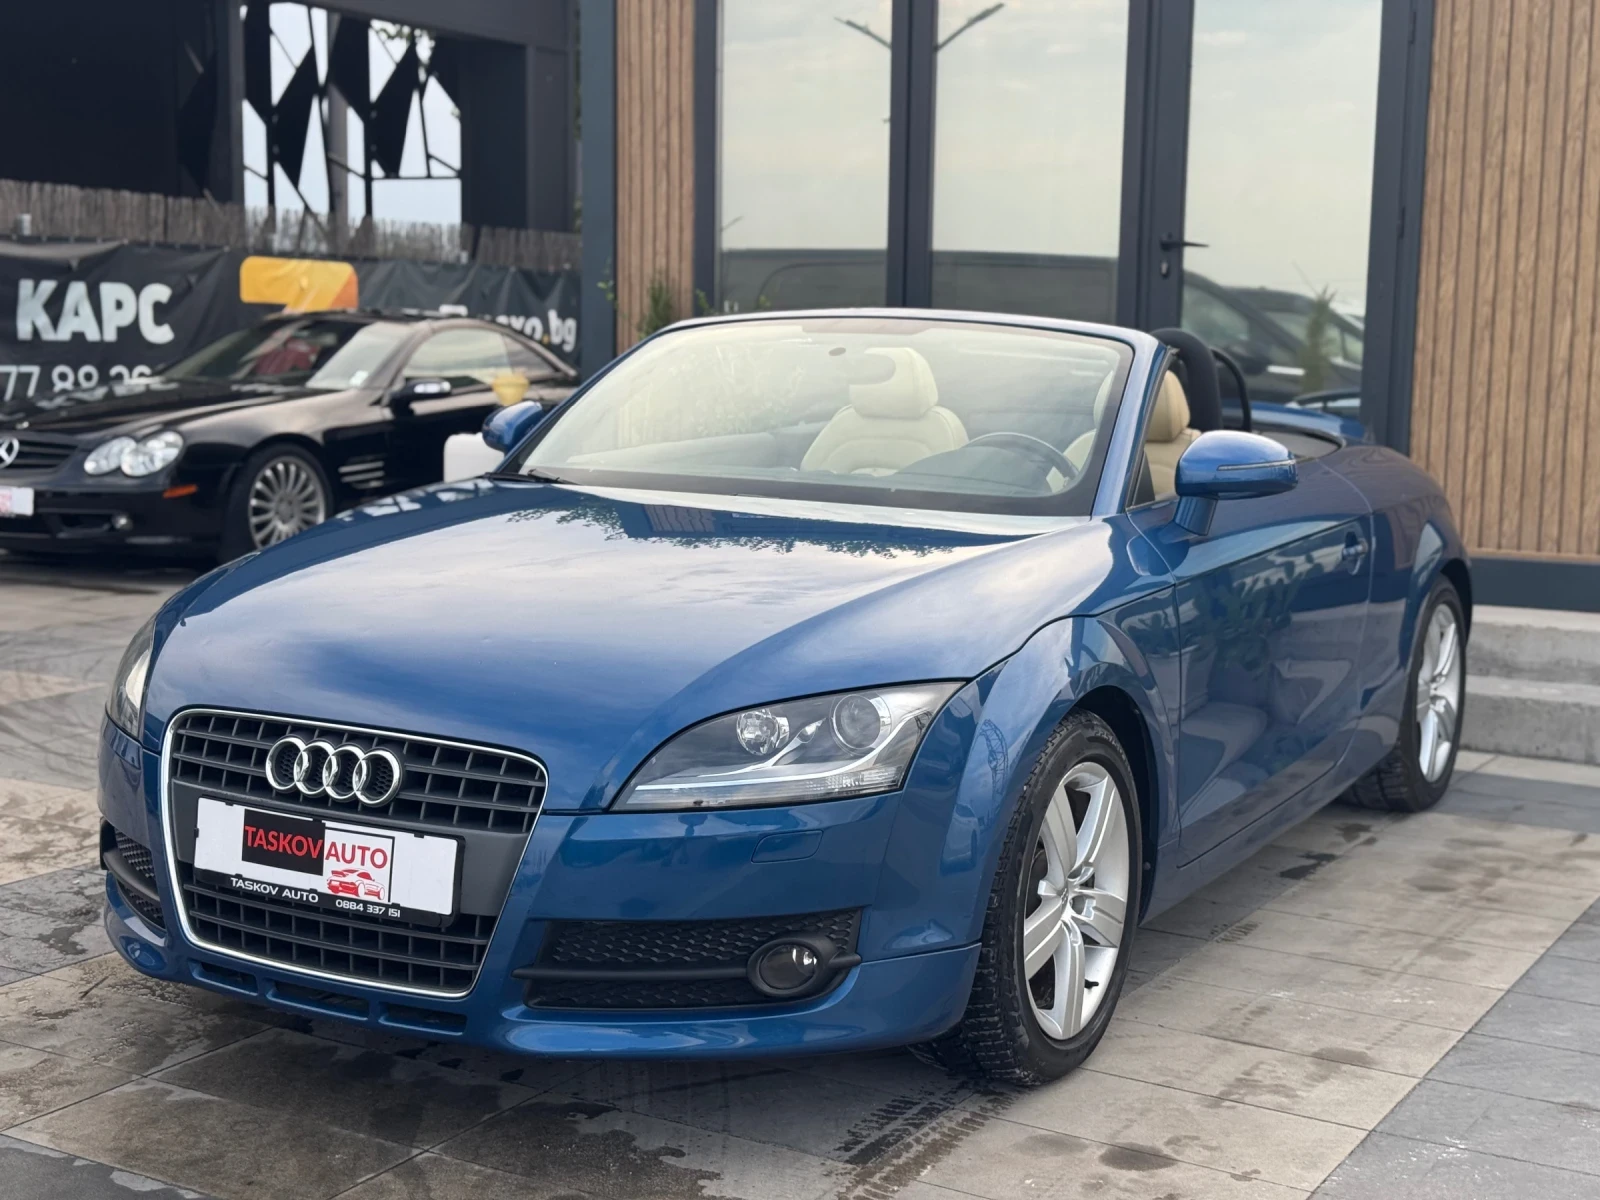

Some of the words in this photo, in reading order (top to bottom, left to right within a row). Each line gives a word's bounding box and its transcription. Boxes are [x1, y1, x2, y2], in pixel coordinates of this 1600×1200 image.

[244, 825, 323, 859] TASKOV
[325, 841, 388, 869] AUTO
[230, 877, 279, 896] TASKOV
[282, 888, 319, 903] AUTO
[335, 899, 364, 912] 0884
[366, 904, 386, 916] 337
